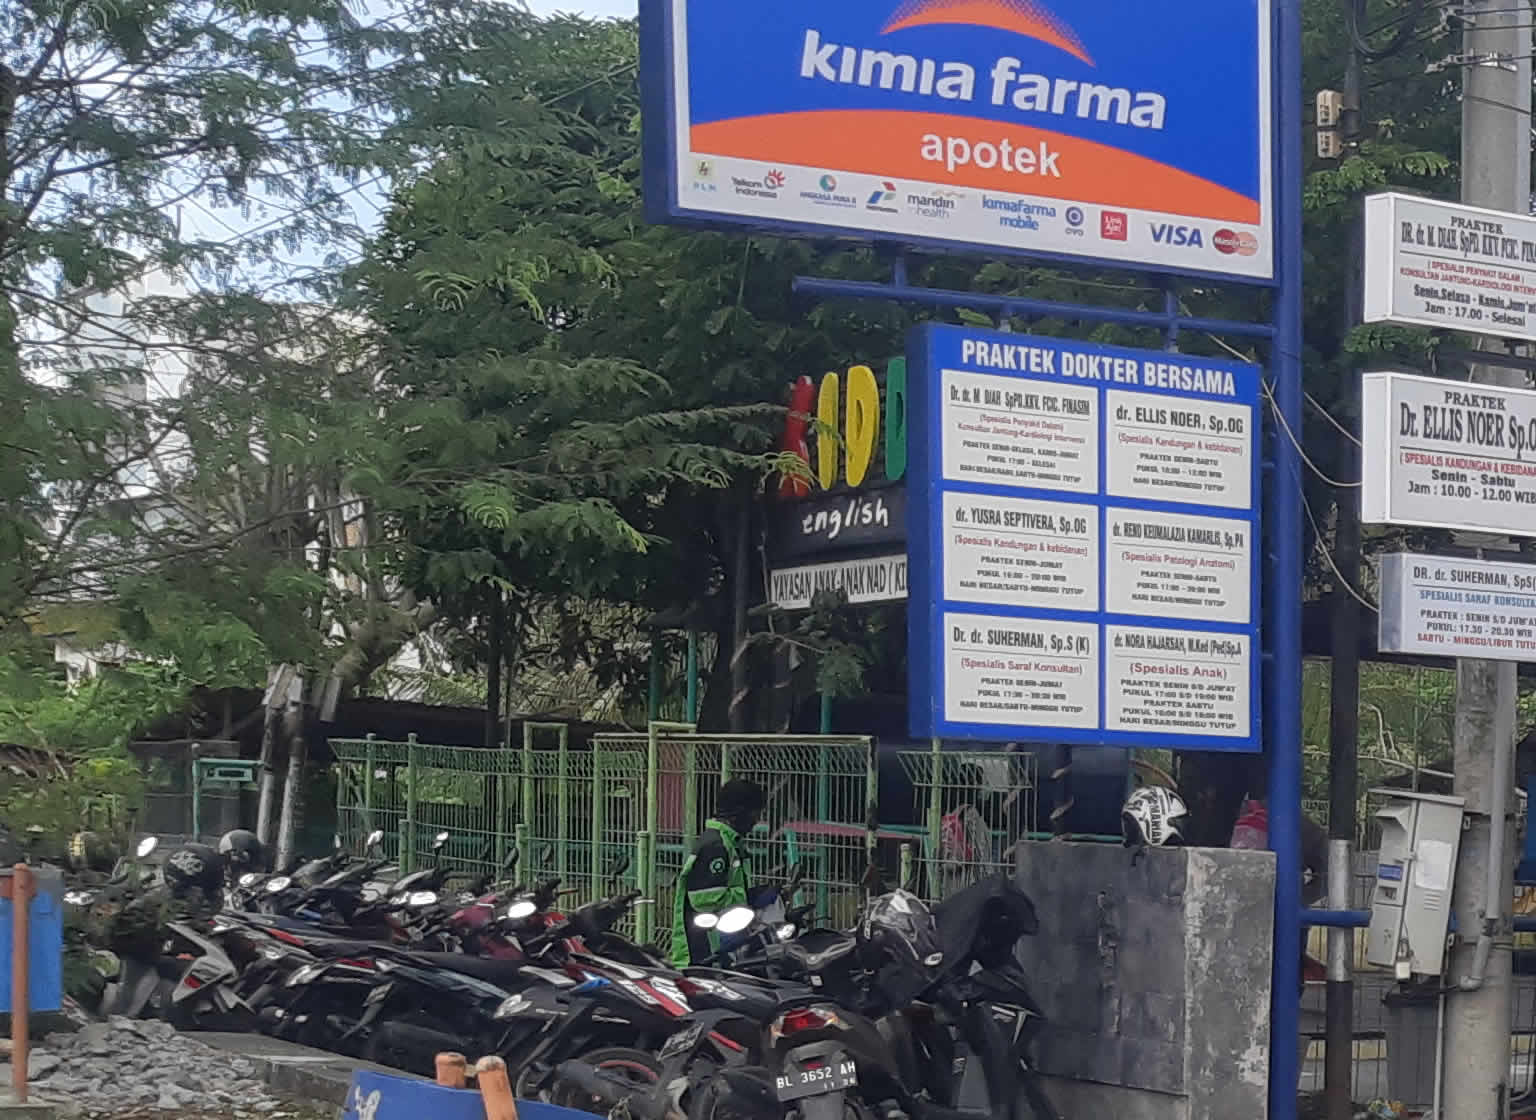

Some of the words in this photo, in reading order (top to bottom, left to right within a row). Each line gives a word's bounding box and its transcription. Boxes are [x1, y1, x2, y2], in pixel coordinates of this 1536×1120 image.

[800, 29, 976, 101] kimia
[988, 55, 1166, 130] farma
[920, 132, 1062, 179] apotek
[999, 215, 1040, 231] mobile
[1148, 221, 1204, 249] VISA
[1451, 216, 1503, 235] PRAKTEK
[1425, 301, 1445, 314] Jam
[1455, 306, 1482, 320] 17.00
[1491, 311, 1526, 327] Selesai
[962, 339, 1056, 374] PRAKTEK
[1061, 352, 1139, 385] DOKTER
[1143, 361, 1237, 396] BERSAMA
[1444, 391, 1506, 411] PRAKTEK
[1116, 404, 1131, 421] dr.
[1135, 407, 1167, 425] ELLIS
[1170, 410, 1206, 430] NOER,
[1209, 415, 1244, 435] Sp.OG
[1400, 402, 1419, 437] Dr.
[1422, 405, 1463, 443] ELLIS
[1466, 410, 1505, 448] NOER
[1431, 468, 1467, 483] Senin
[1481, 473, 1516, 489] Sabtu
[1408, 480, 1431, 495] Jam
[1441, 485, 1472, 498] 10.00
[1482, 488, 1512, 502] 12.00
[802, 497, 888, 539] english
[956, 506, 968, 523] dr.
[970, 508, 1002, 526] YUSRA
[1003, 511, 1057, 533] SEPTIVERA,
[1059, 516, 1087, 536] Sp.OG
[772, 570, 812, 604] YAYASAN
[867, 563, 886, 594] NAD
[1413, 566, 1432, 580] DR.
[1450, 569, 1511, 589] SUHERMAN,
[1419, 590, 1463, 601] SPESIALIS
[1420, 609, 1458, 621] PRAKTEK
[953, 625, 966, 643] Dr.
[970, 627, 983, 644] dr.
[987, 629, 1048, 652] SUHERMAN,
[1050, 634, 1073, 654] Sp.S
[1075, 636, 1090, 656] (K)
[1417, 632, 1445, 643] SABTU
[1460, 624, 1482, 634] 17.30
[961, 657, 1005, 670] (Spesialis
[1007, 659, 1032, 671] Saraf
[1033, 662, 1083, 676] Konsultan)
[1130, 662, 1190, 675] (Spesialis
[1192, 666, 1228, 681] Anak)
[777, 1076, 793, 1089] BL
[801, 1067, 833, 1084] 3652
[840, 1062, 856, 1076] AH
